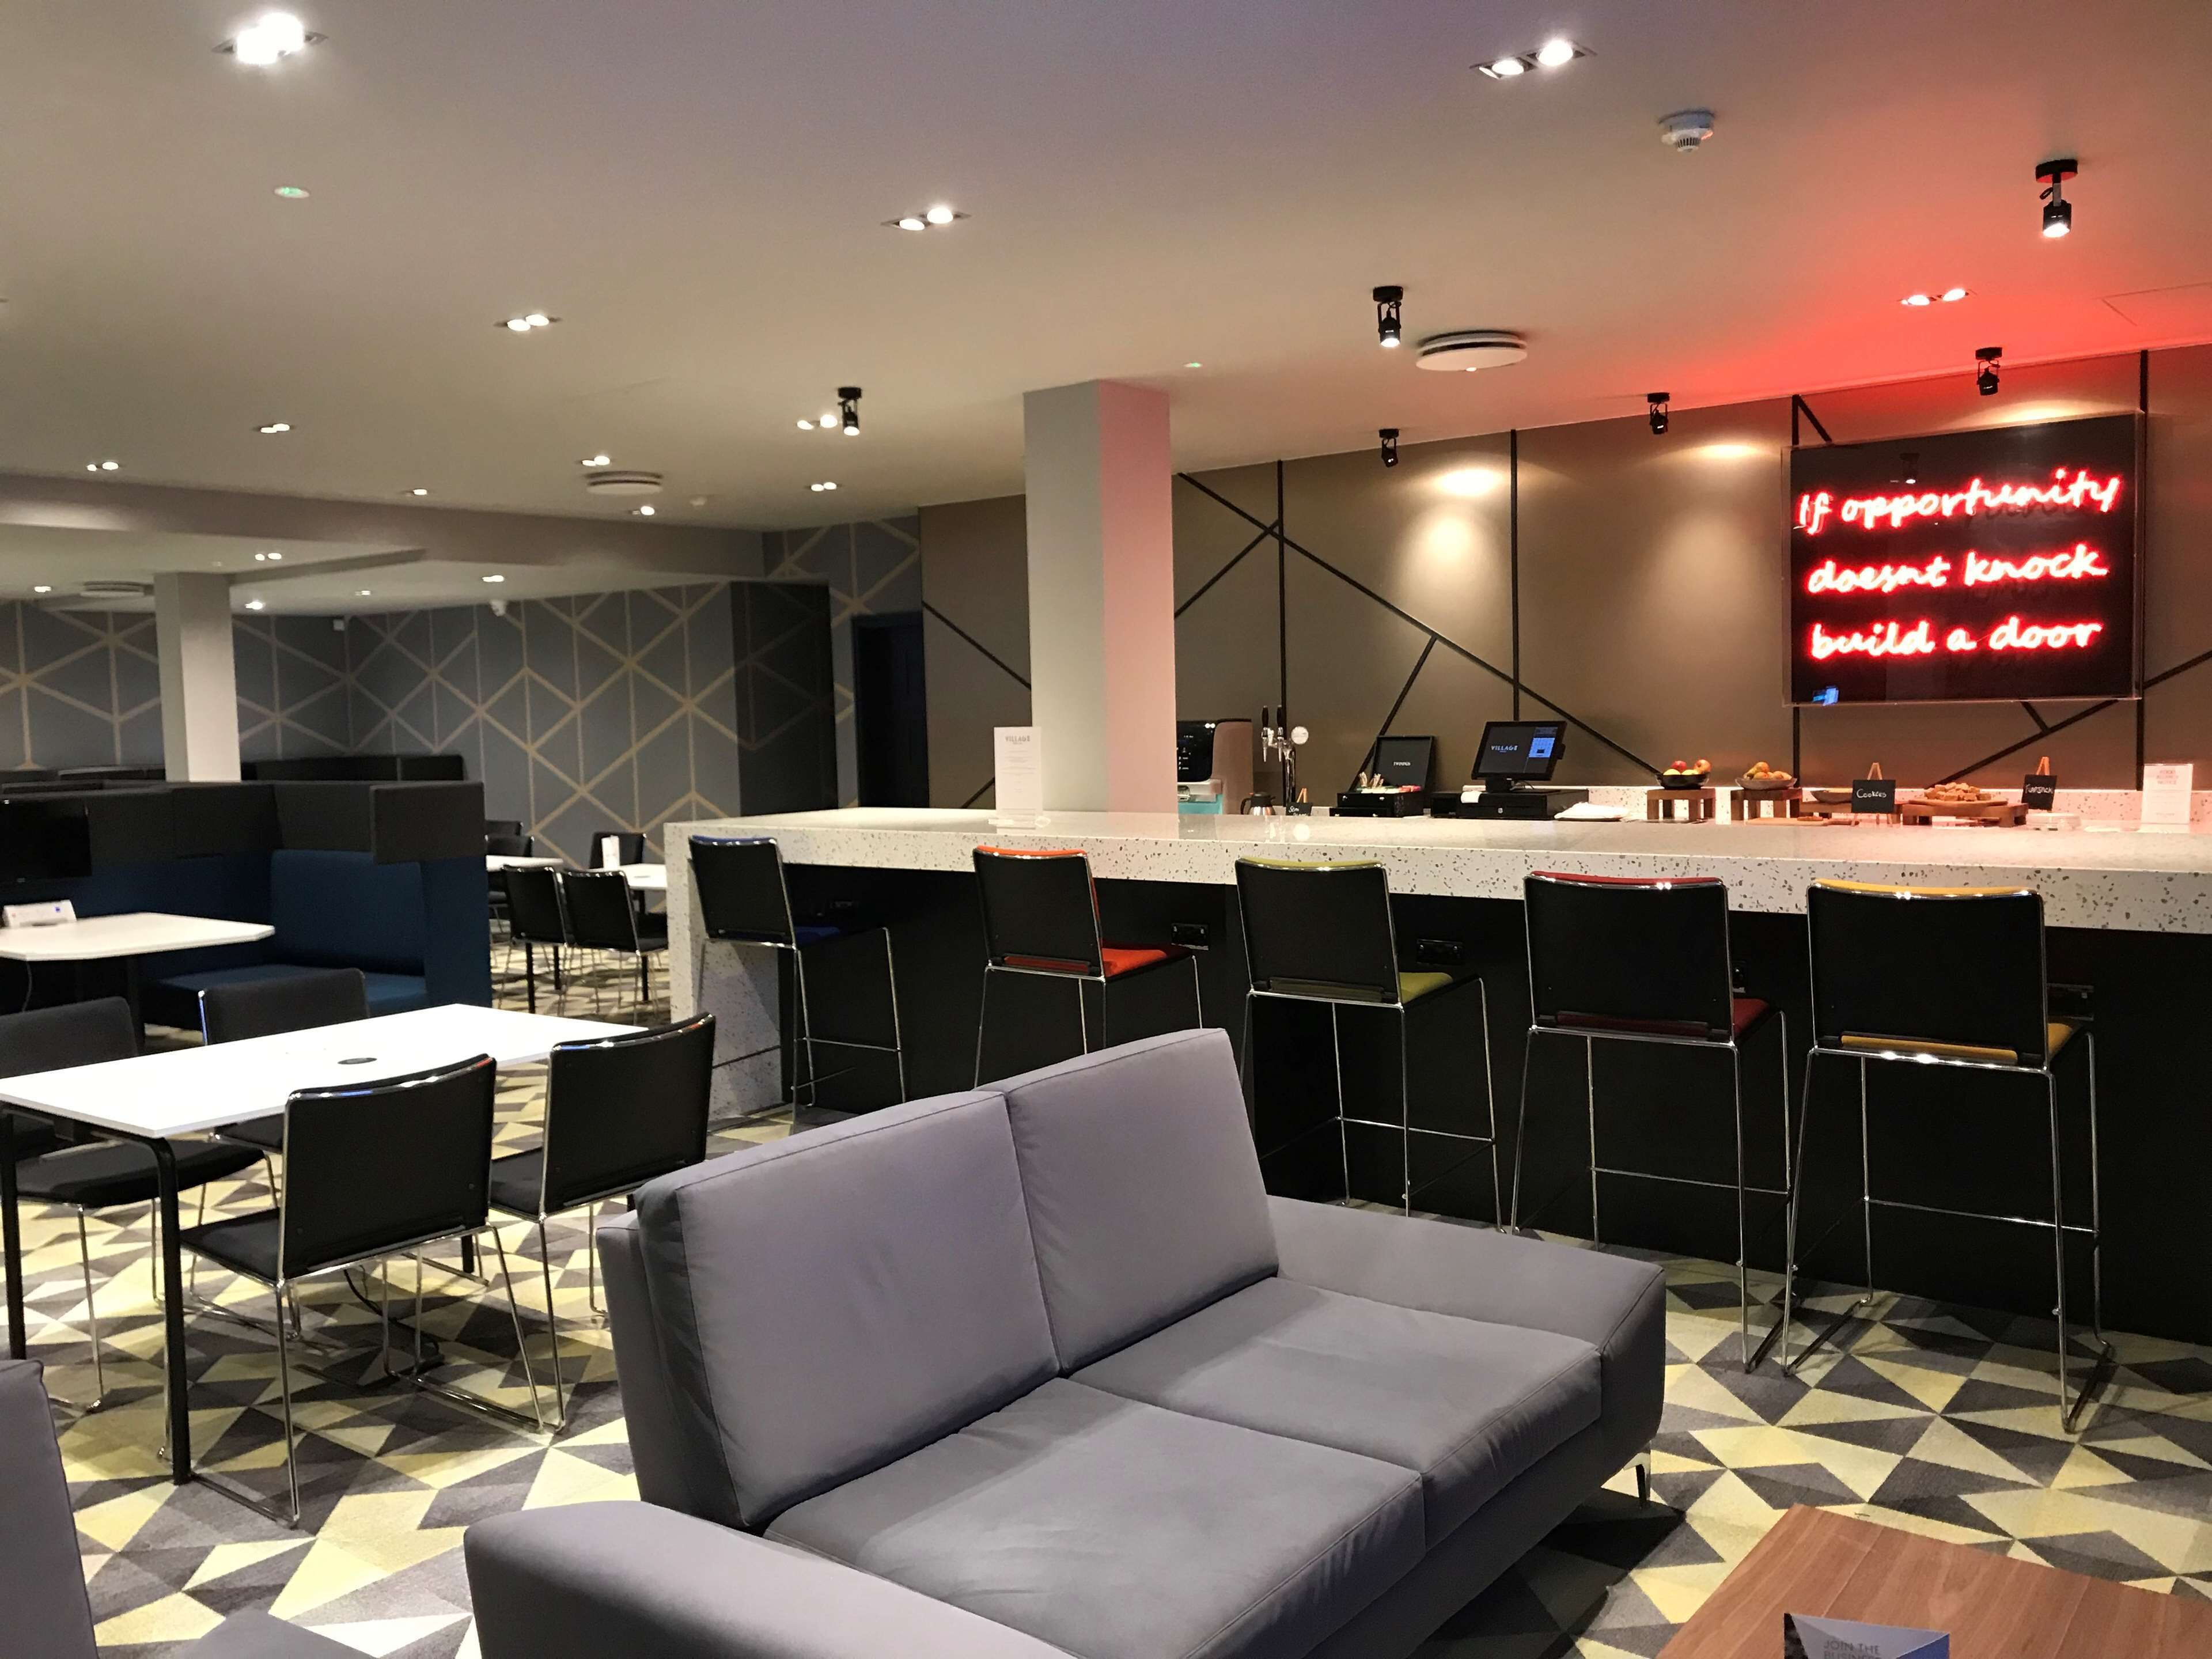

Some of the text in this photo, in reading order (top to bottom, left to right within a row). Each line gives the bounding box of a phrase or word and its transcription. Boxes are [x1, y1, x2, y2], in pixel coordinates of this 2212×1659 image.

[1798, 468, 2122, 535] If opportunity
[1808, 543, 2109, 593] doesnt knock
[1810, 616, 2103, 660] build a door
[1823, 1639, 1880, 1656] JOIN THE
